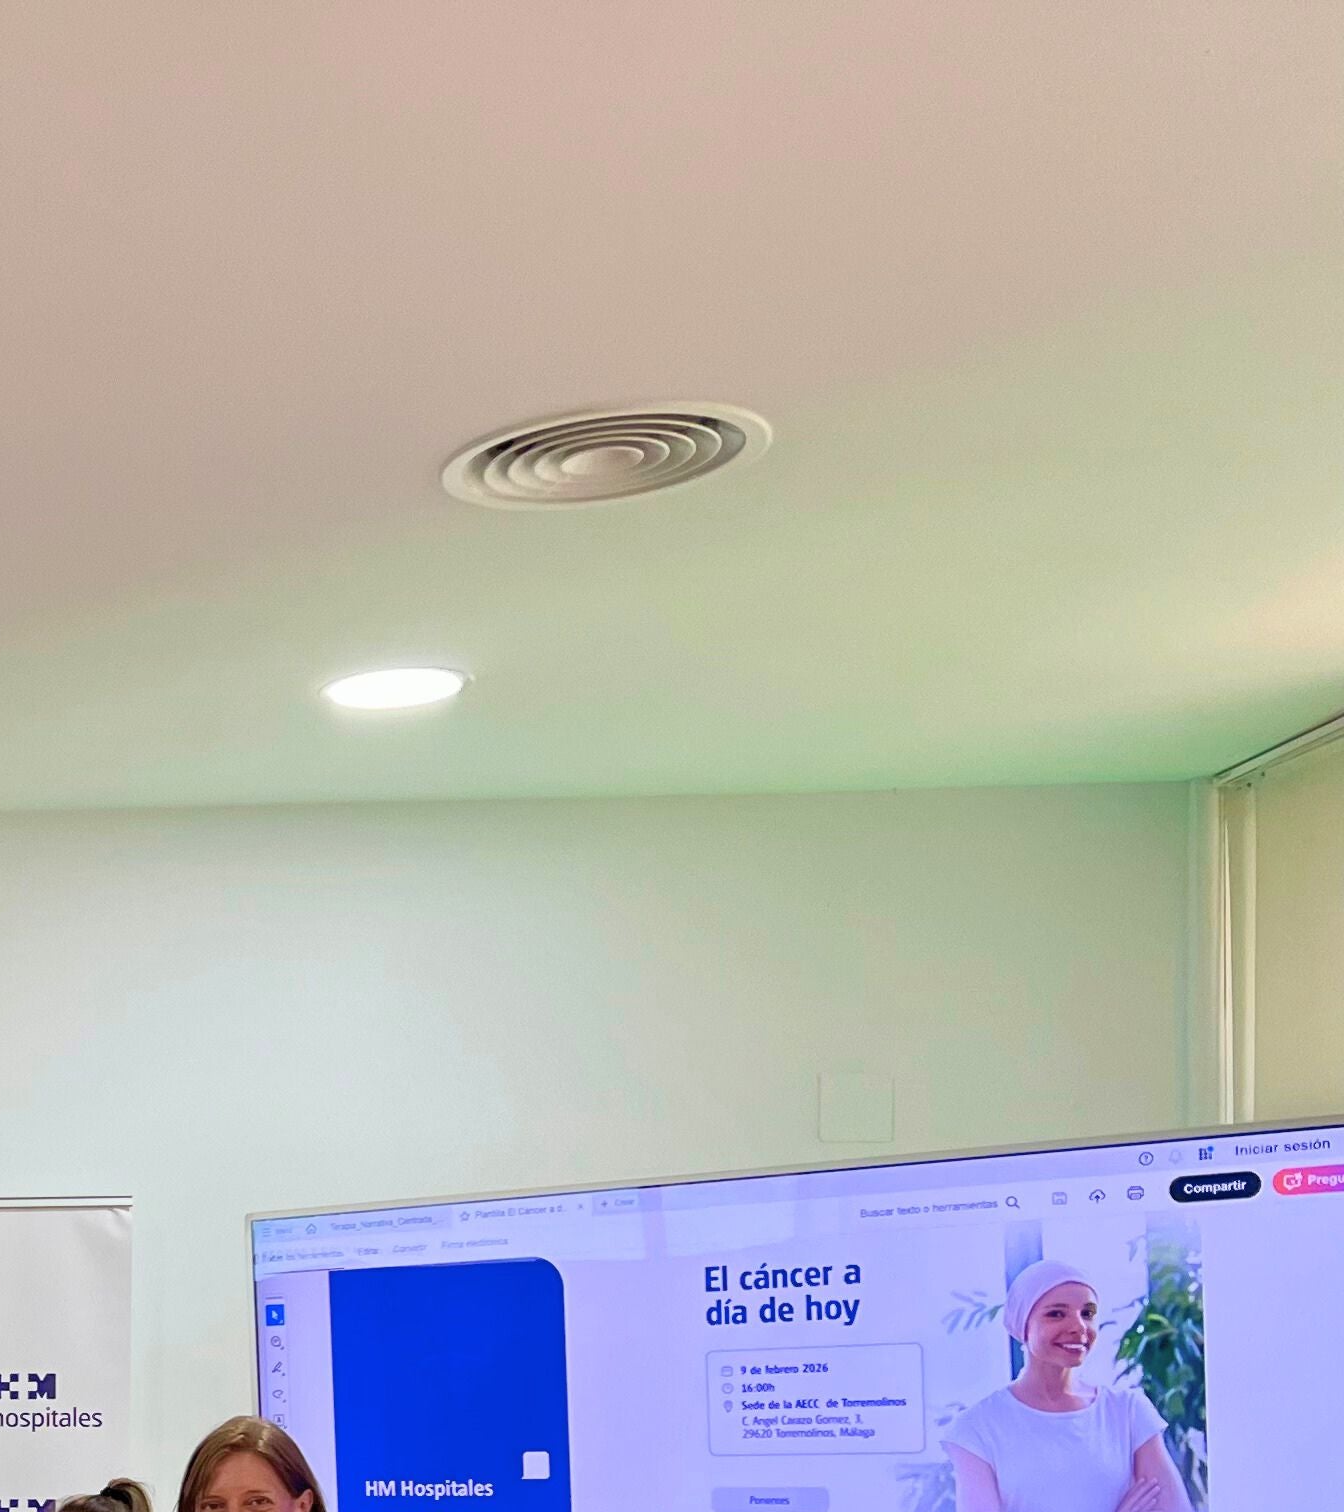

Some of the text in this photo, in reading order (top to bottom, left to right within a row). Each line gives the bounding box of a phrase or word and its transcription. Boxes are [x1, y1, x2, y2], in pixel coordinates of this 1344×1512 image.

[1235, 1139, 1331, 1156] Iniciar sesión
[1183, 1180, 1247, 1194] Compartir
[705, 1262, 861, 1292] El cáncer a
[706, 1294, 861, 1326] día de hoy
[740, 1363, 829, 1375] 9 de febrero 2026
[742, 1397, 907, 1410] Sede de la AECC de Torremolinos
[365, 1479, 494, 1501] HM Hospitales
